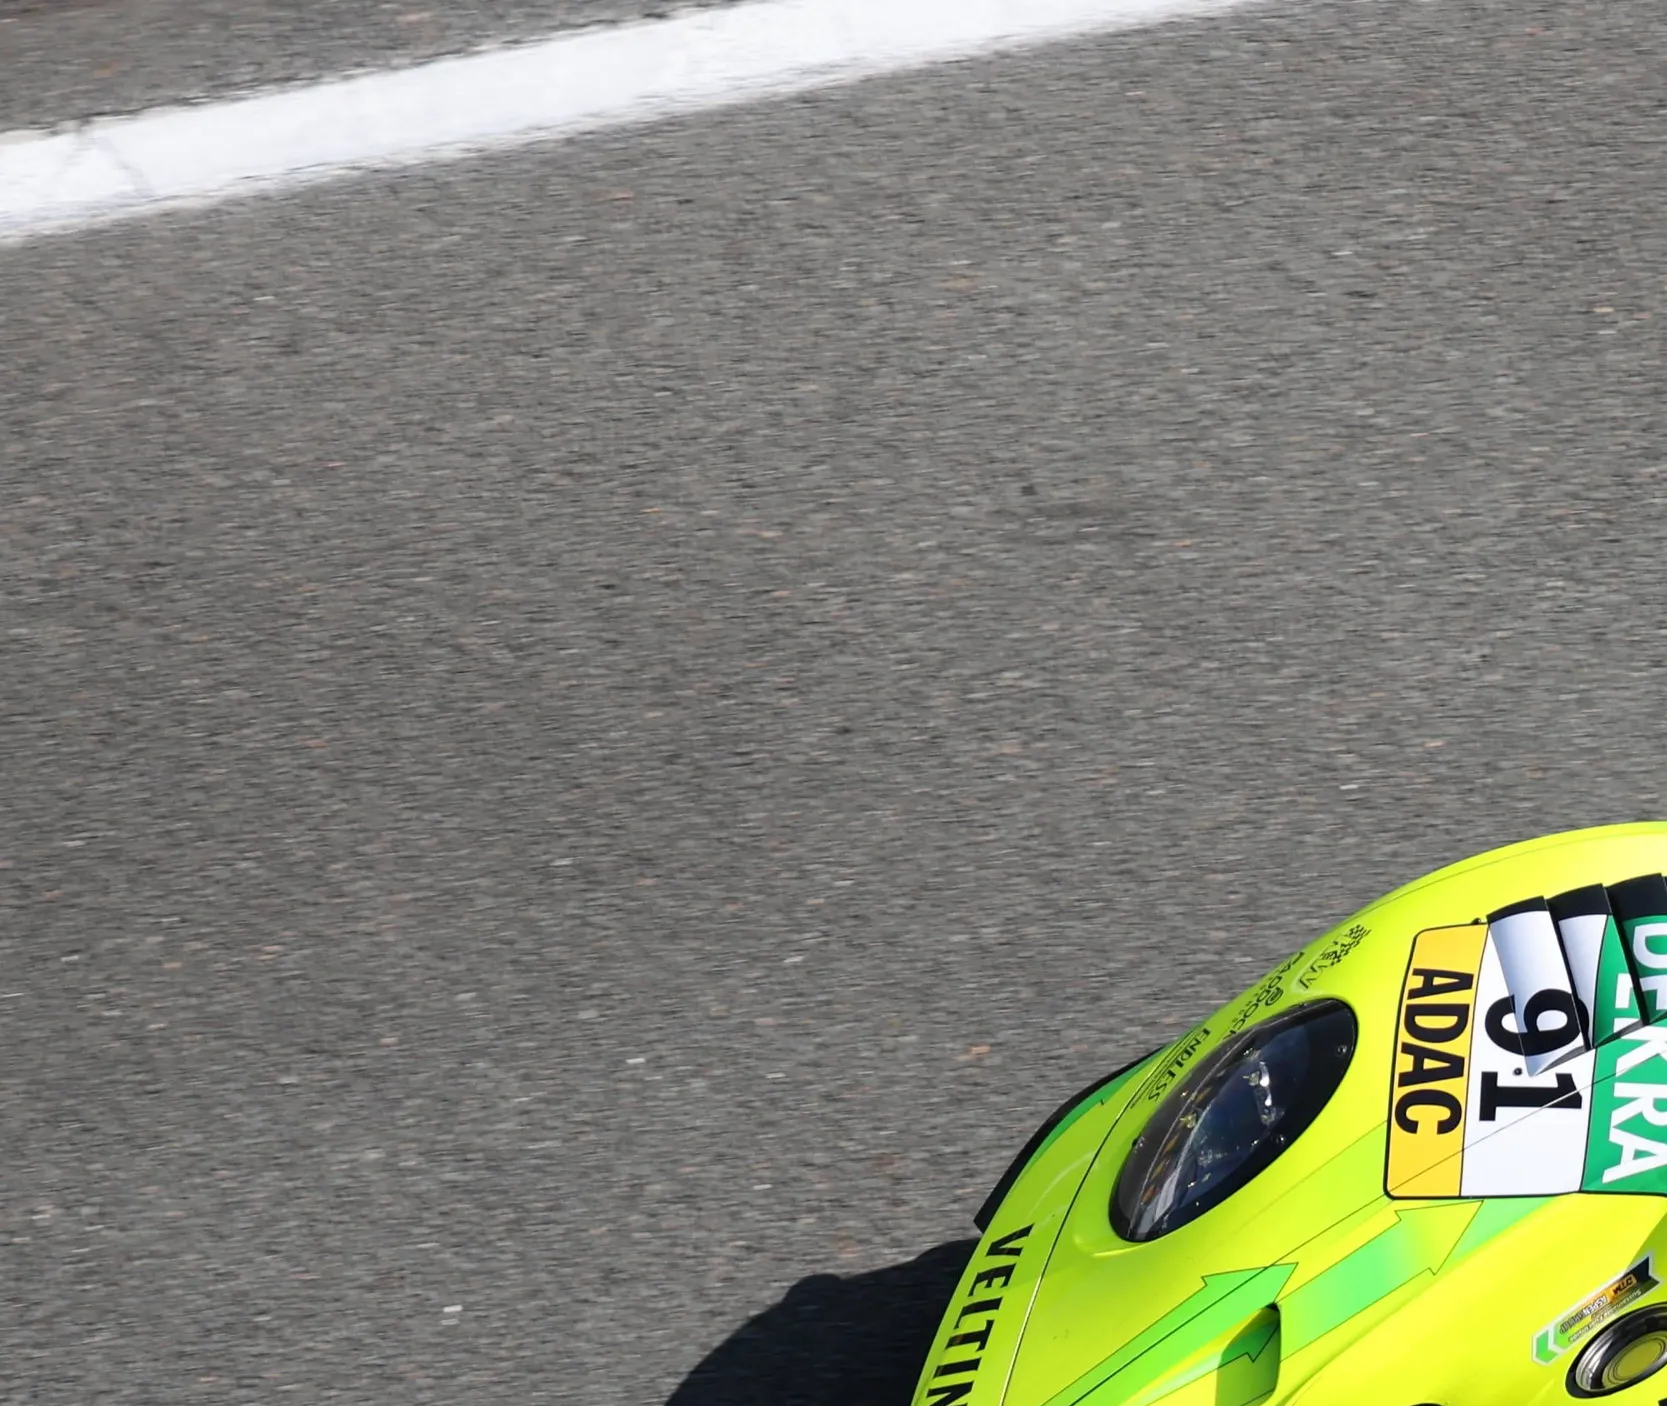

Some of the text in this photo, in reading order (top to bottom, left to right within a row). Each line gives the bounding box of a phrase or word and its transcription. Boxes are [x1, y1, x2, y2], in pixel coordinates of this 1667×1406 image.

[1148, 1028, 1210, 1102] ENDLESS
[1394, 968, 1474, 1134] ADAC
[1479, 988, 1591, 1122] 91
